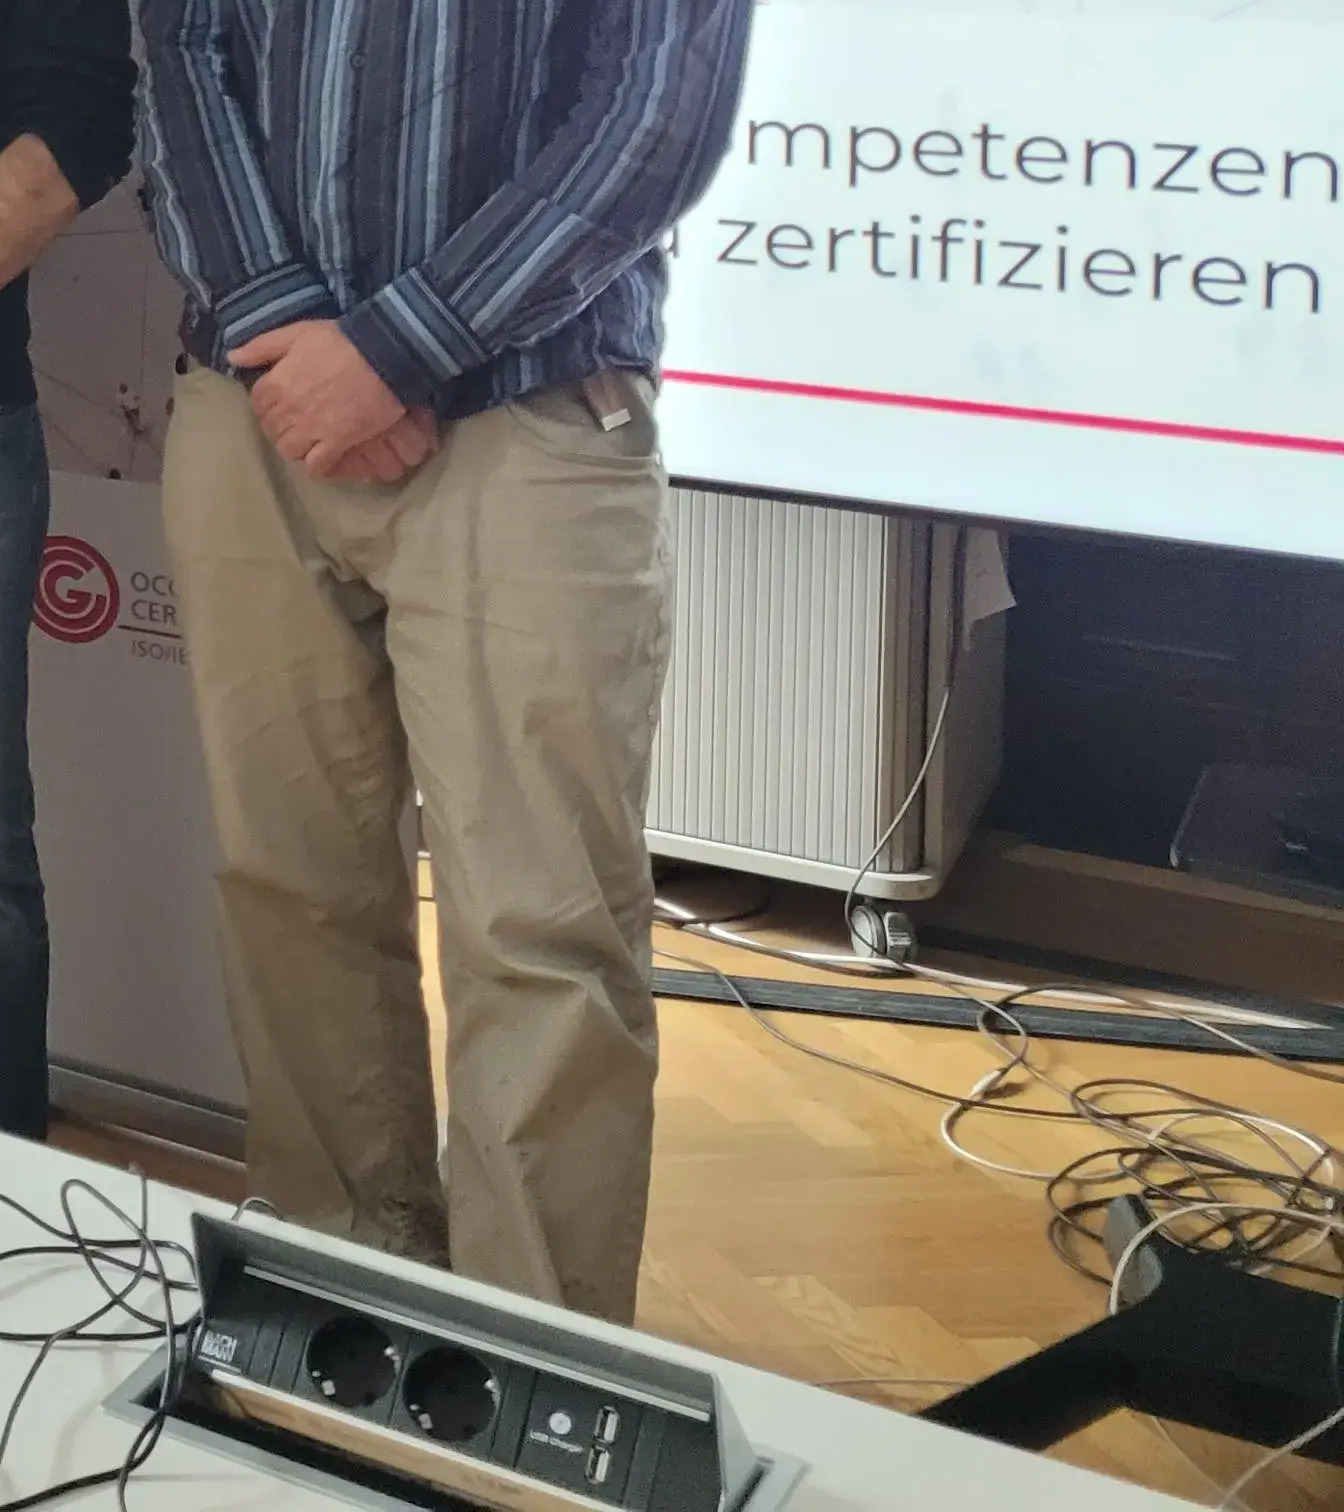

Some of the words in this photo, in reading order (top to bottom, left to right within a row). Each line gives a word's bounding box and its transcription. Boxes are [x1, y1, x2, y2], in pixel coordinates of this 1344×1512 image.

[747, 118, 1340, 203] mpetenzen
[716, 213, 1322, 314] zertifizieren
[130, 598, 178, 626] CER
[131, 639, 190, 666] ISO/IE
